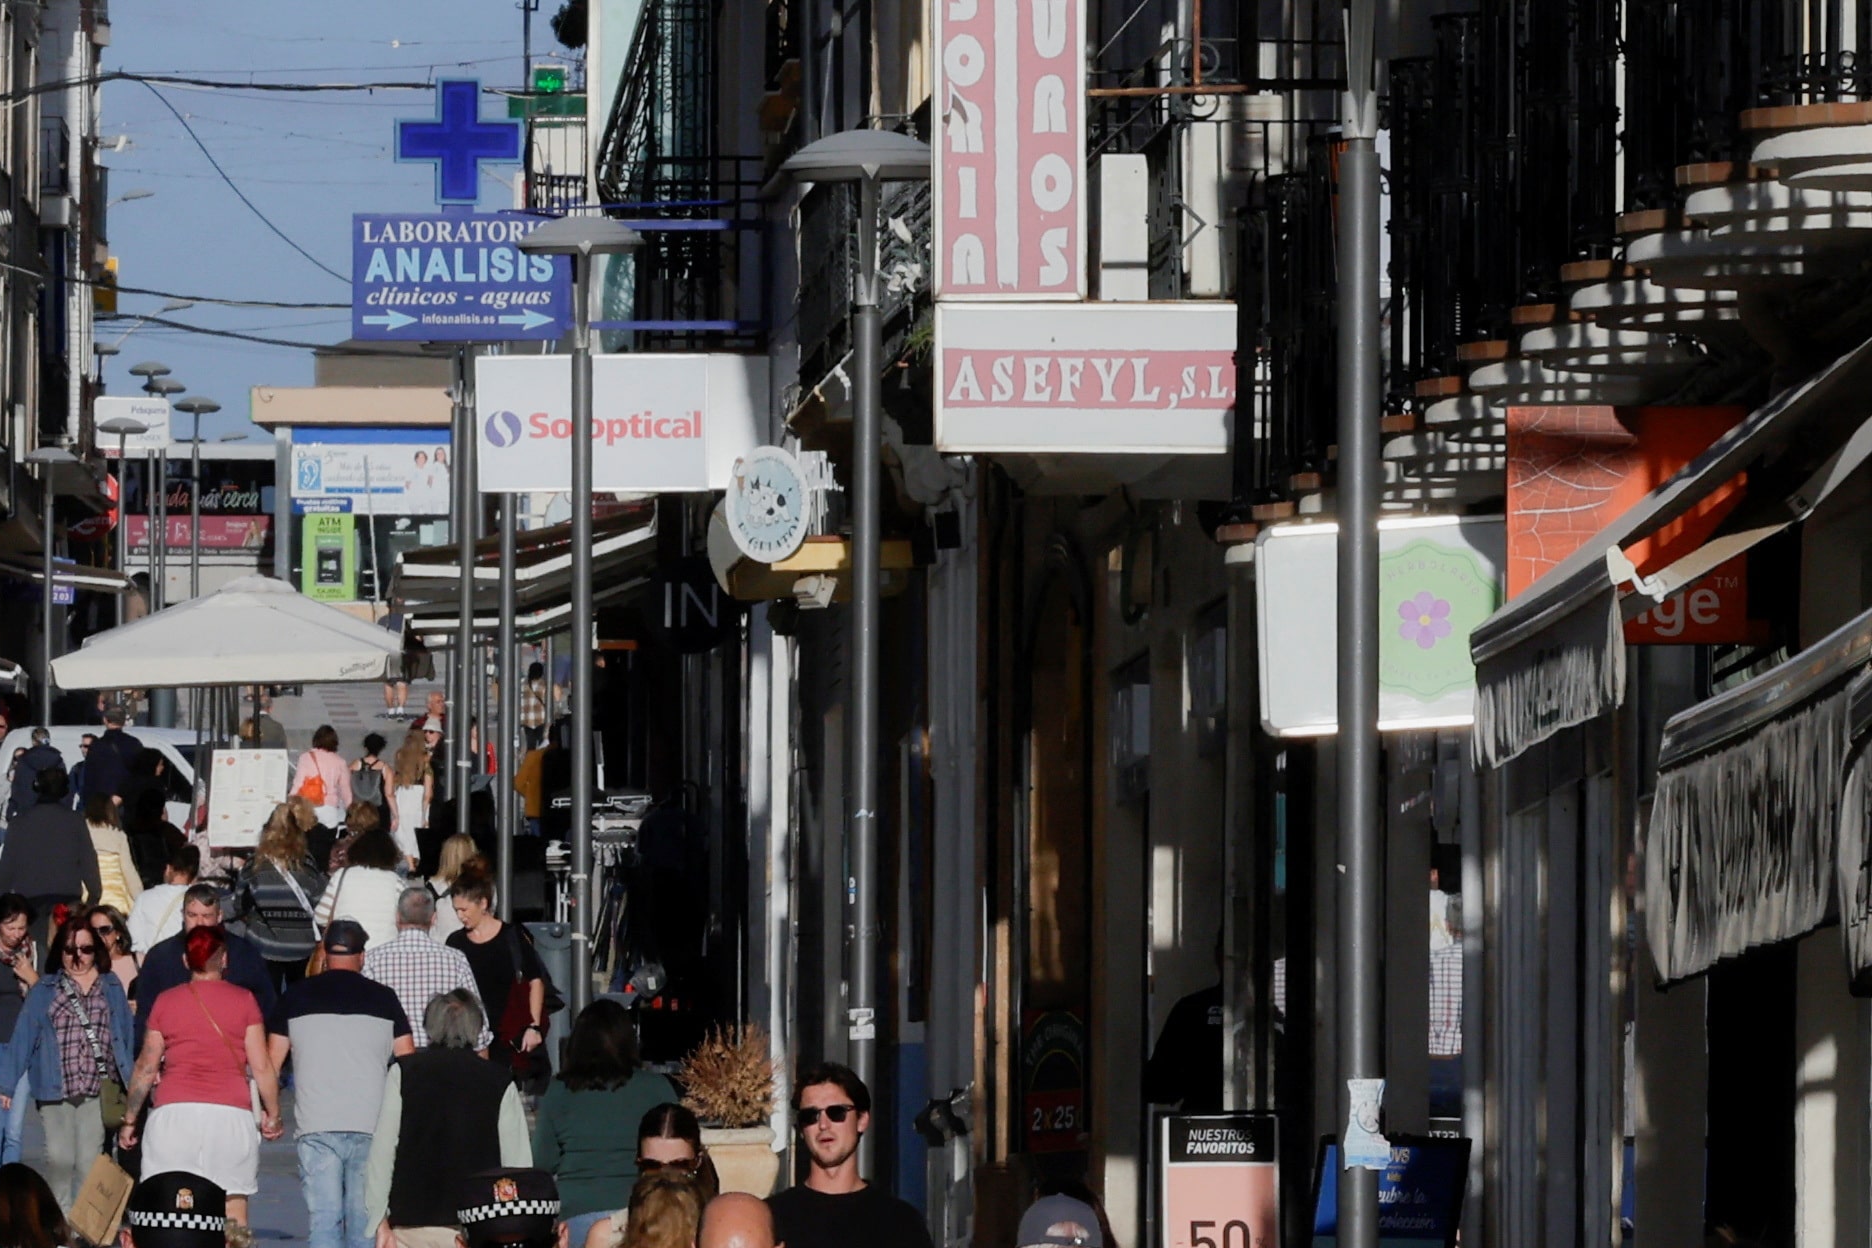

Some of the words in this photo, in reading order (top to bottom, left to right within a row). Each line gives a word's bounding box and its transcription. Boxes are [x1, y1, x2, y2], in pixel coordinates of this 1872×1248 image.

[362, 220, 555, 243] LABORATORI
[364, 247, 554, 283] ANALISIS
[366, 286, 458, 305] clínicos
[480, 289, 552, 310] aguas
[421, 312, 496, 325] infoanalisis.es
[529, 410, 702, 446] Sooptical
[318, 518, 341, 527] ATM
[1188, 1128, 1252, 1141] NUESTROS
[1186, 1142, 1256, 1155] FAVORITOS
